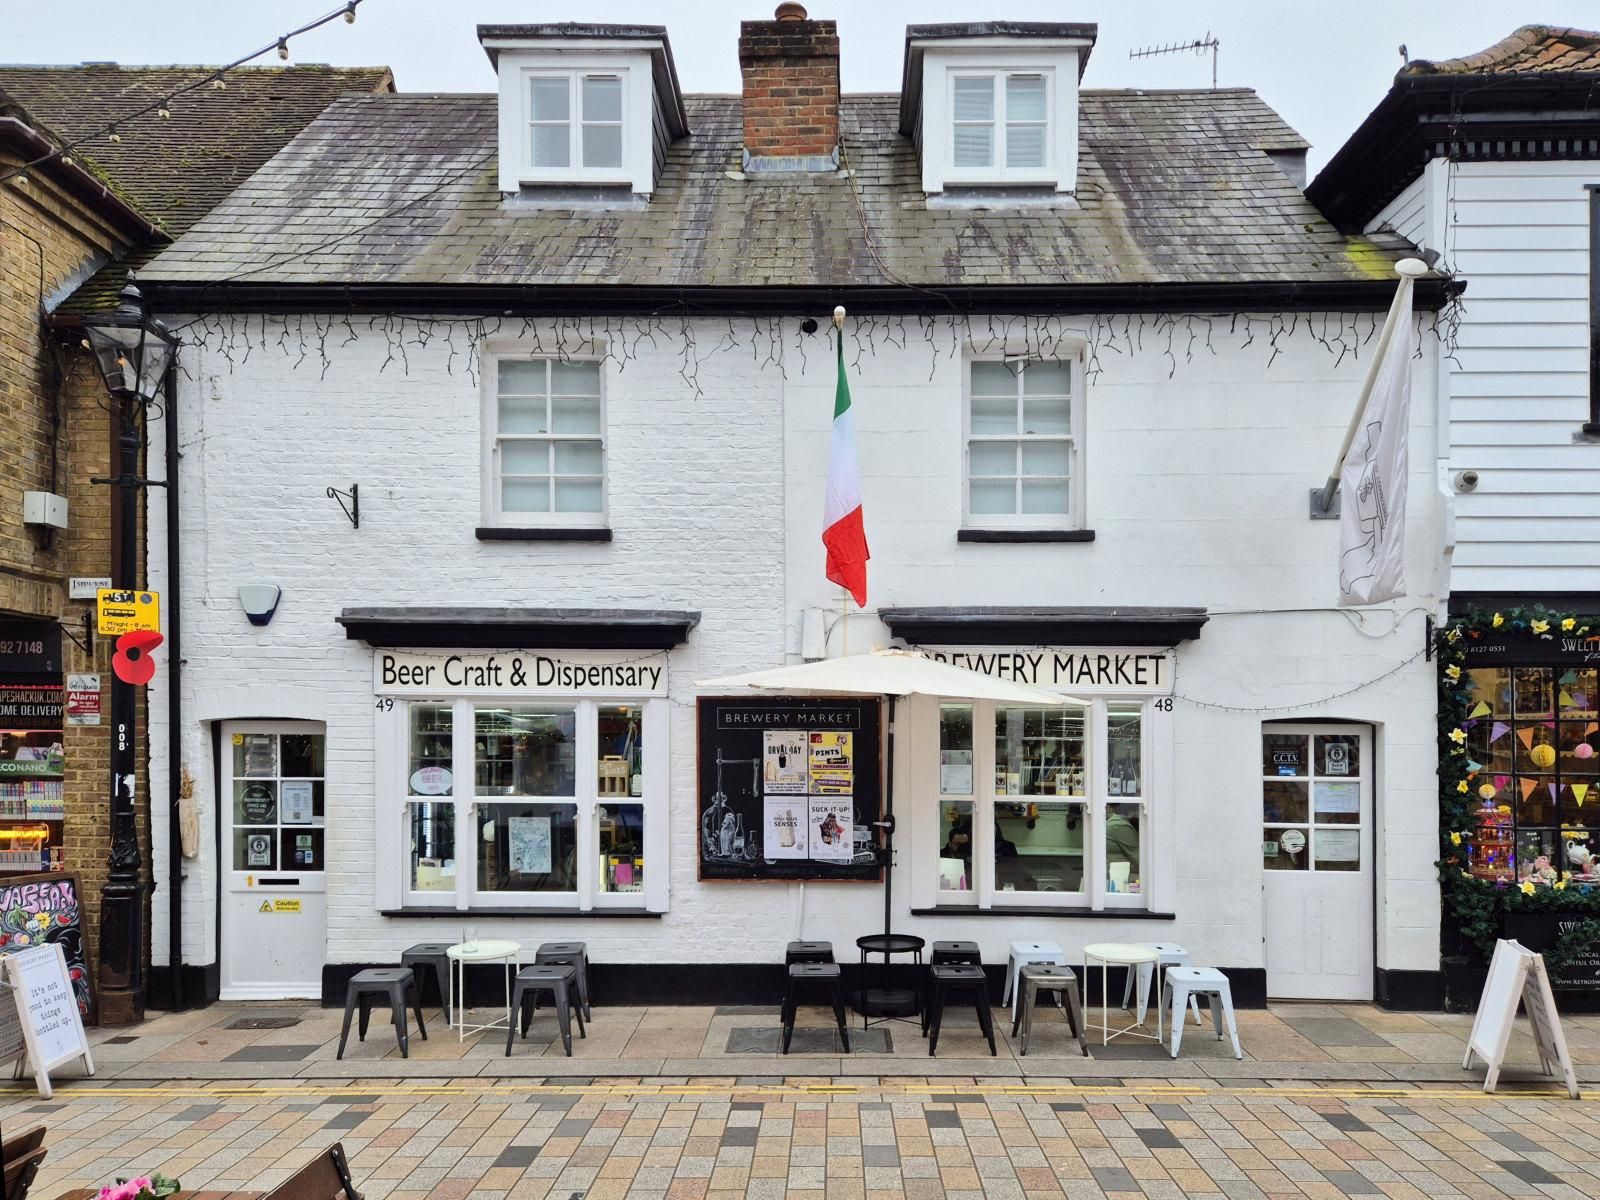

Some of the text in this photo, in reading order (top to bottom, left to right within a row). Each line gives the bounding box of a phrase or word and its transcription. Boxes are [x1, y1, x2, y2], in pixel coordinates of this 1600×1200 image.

[16, 640, 43, 654] 7148
[382, 655, 662, 690] Beer Craft & Dispensary
[924, 654, 1166, 685] WERY MARKET
[70, 692, 99, 701] Alarm
[20, 705, 63, 716] DELIVERY
[375, 698, 394, 712] 49
[1155, 698, 1174, 712] 48
[725, 712, 852, 723] BREWERY MARKET
[1273, 754, 1299, 762] C.C.T.V.
[0, 763, 46, 772] CONANO
[422, 774, 442, 784] BEER
[40, 1007, 61, 1020] things
